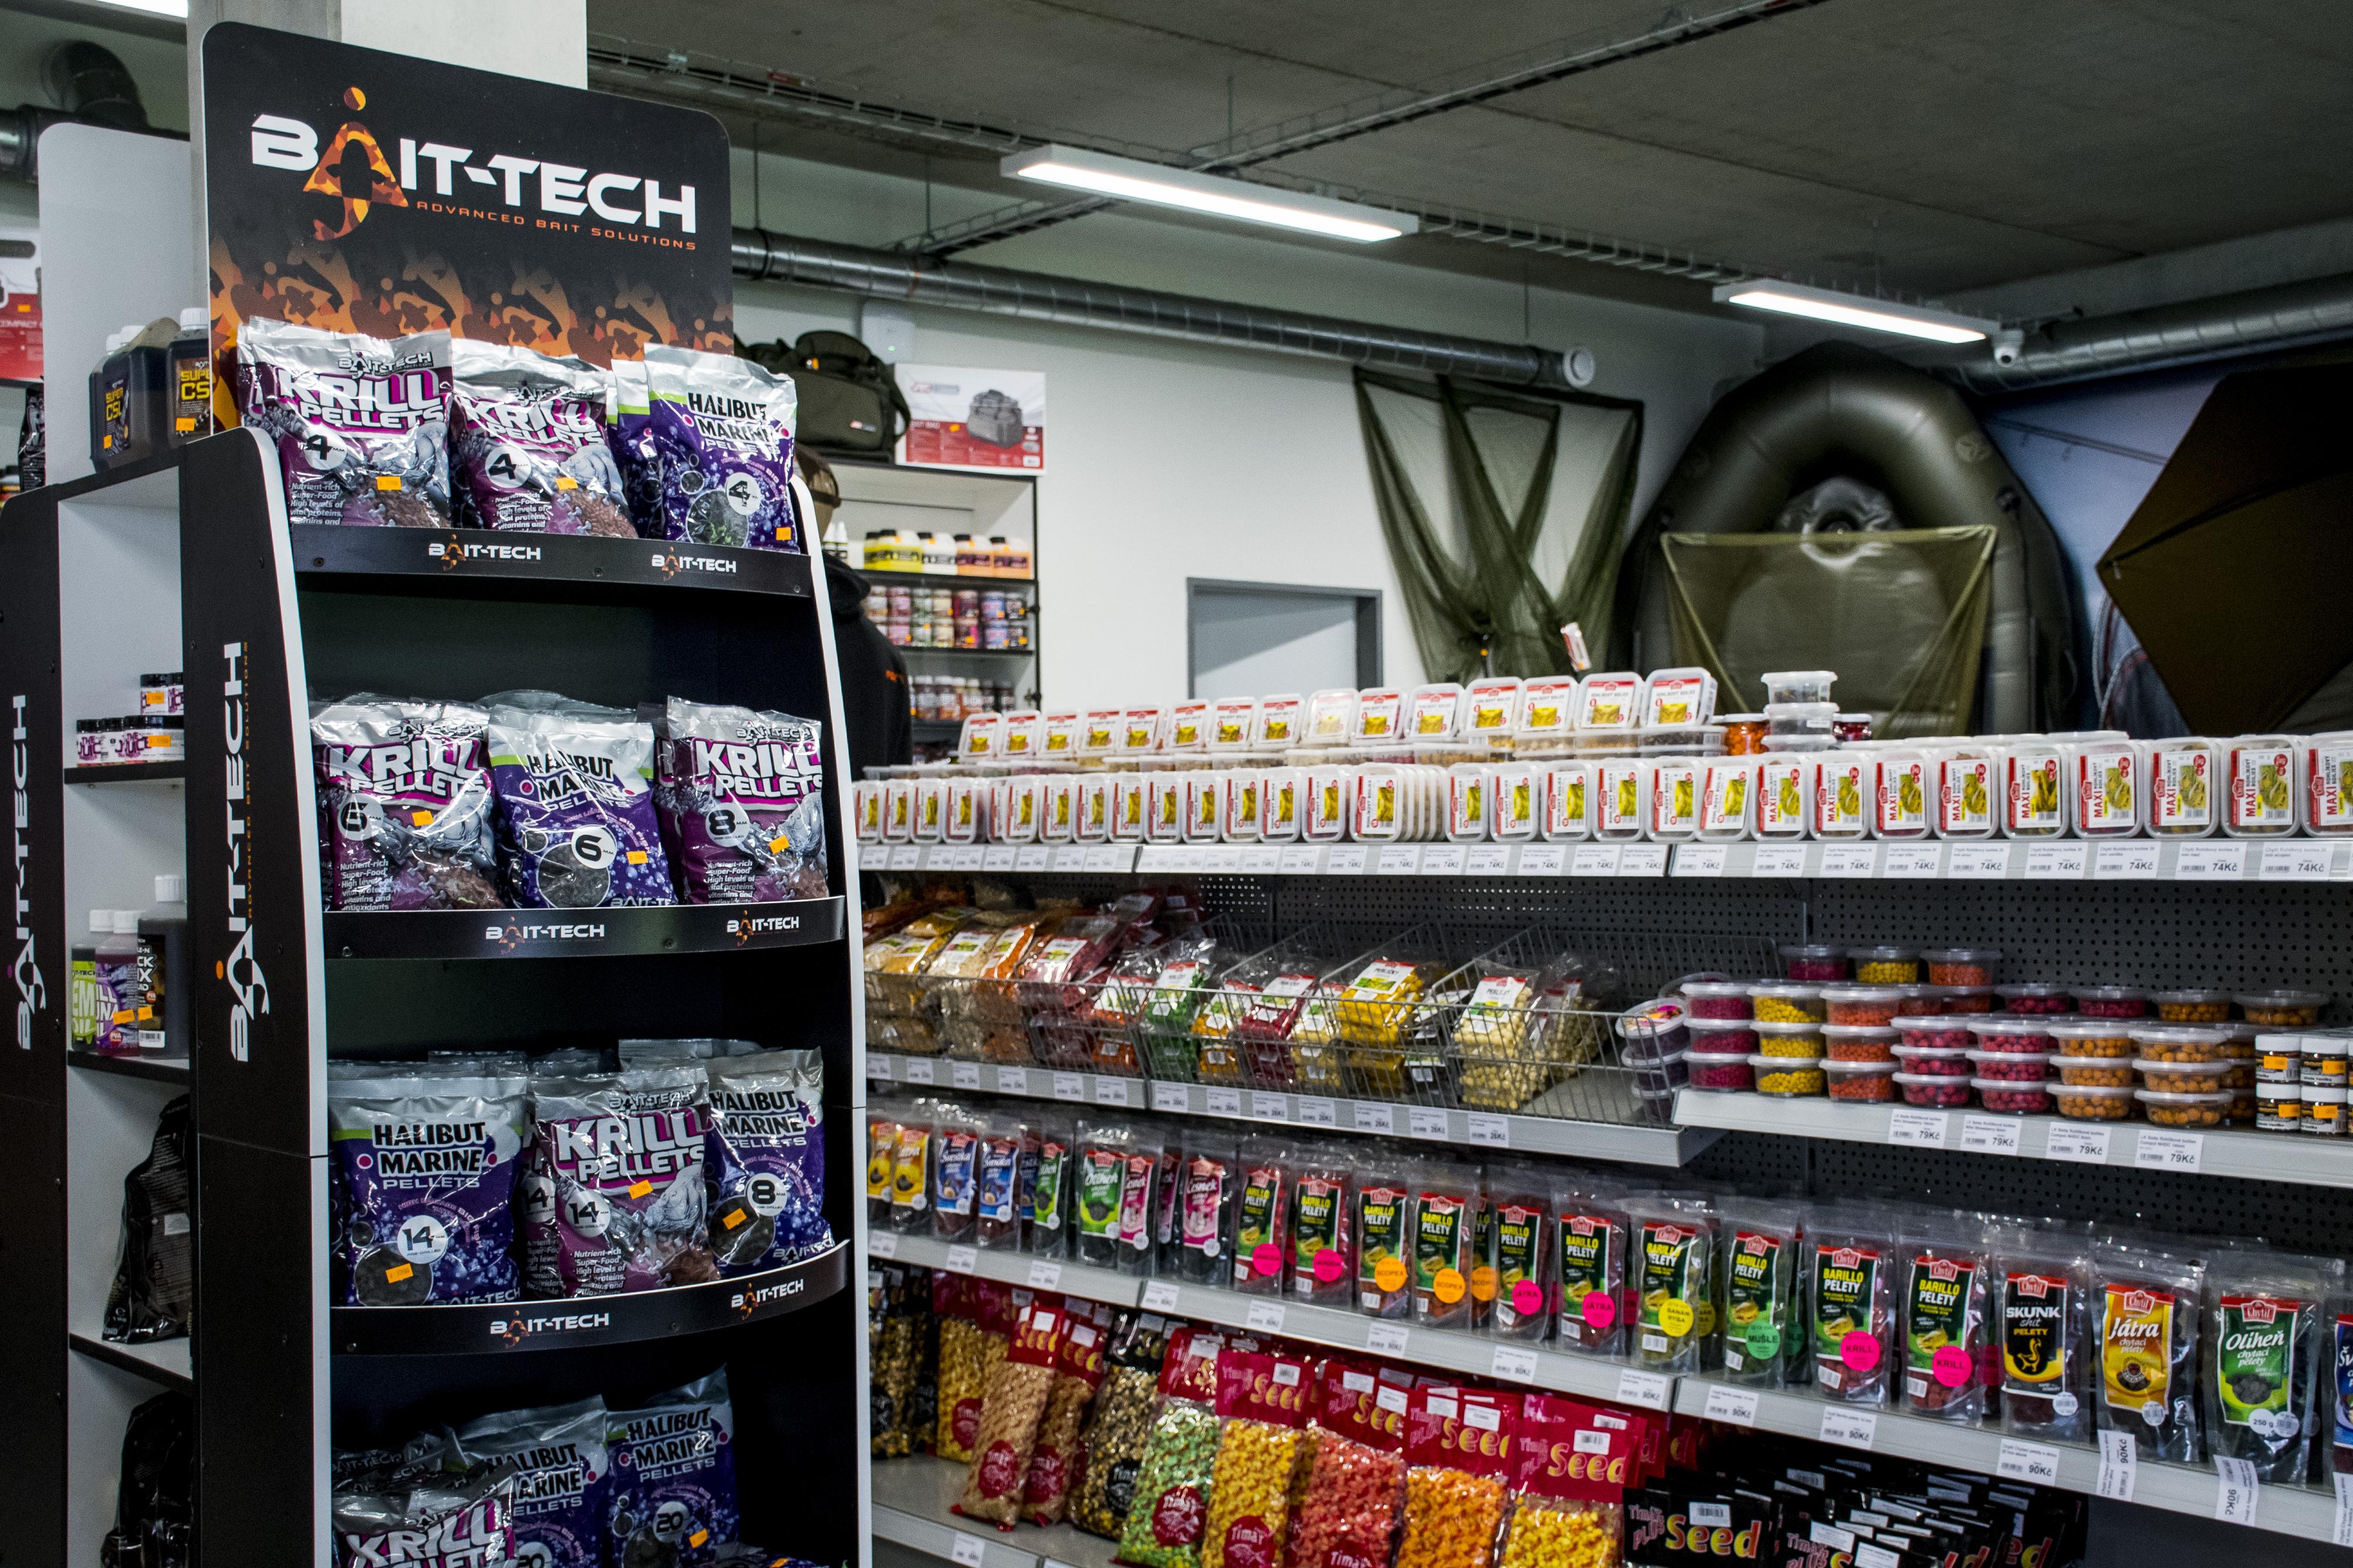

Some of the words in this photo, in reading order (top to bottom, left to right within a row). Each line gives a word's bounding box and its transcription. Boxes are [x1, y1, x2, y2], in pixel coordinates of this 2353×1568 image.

[252, 96, 696, 238] BAIT-TECH
[416, 201, 525, 225] ADVANCED
[536, 219, 580, 233] BAIT
[591, 228, 696, 251] SOLUTIONS
[277, 369, 442, 413] KRILL
[301, 401, 446, 429] PELLETS
[461, 395, 598, 433] KRILL
[688, 392, 766, 421] HALIBUT
[488, 422, 605, 449] PELLETS
[489, 453, 518, 480] 4
[429, 541, 541, 566] BAIT-TECH
[652, 552, 736, 576] BAIT-TECH
[328, 738, 485, 781] KRILL
[695, 740, 822, 778] KRILL
[351, 772, 488, 796] PELLETS
[1952, 795, 1961, 820] MAXI
[2094, 790, 2102, 818] MAXI
[2167, 789, 2175, 816] MAXI
[2246, 789, 2255, 816] MAXI
[2327, 786, 2337, 815] MAXI
[708, 810, 736, 836] 8
[224, 642, 265, 1062] BAIT-TECH
[576, 835, 602, 862] 6
[12, 695, 41, 1050] BAIT-TECH
[341, 859, 388, 870] Nutrient-rich
[1781, 862, 1800, 870] 74Kč
[1850, 862, 1869, 870] 74Kč
[1914, 862, 1934, 870] 74Kč
[2058, 862, 2081, 870] 74Kč
[2212, 863, 2237, 871] 74Kč
[2298, 863, 2324, 872] 74Kč
[342, 880, 357, 889] High
[708, 876, 723, 885] High
[486, 921, 605, 949] BAIT-TECH
[727, 915, 799, 941] BAIT-TECH
[610, 1091, 694, 1115] BAIT-TECH
[374, 1122, 486, 1146] HALIBUT
[556, 1110, 705, 1163] KRILL
[722, 1116, 804, 1136] MARINE
[1992, 1136, 2015, 1147] 79Kč
[2079, 1145, 2103, 1155] 79Kč
[381, 1149, 482, 1175] MARINE
[578, 1145, 705, 1182] PELLETS
[2170, 1153, 2195, 1164] 79Kč
[384, 1177, 479, 1190] PELLETS
[752, 1180, 776, 1205] 8
[569, 1201, 599, 1224] 14
[402, 1226, 434, 1251] 14
[576, 1266, 592, 1276] High
[594, 1266, 616, 1274] levels
[618, 1265, 626, 1273] of
[1735, 1265, 1764, 1279] PELETY
[1737, 1253, 1767, 1270] BARILLO
[1824, 1268, 1864, 1283] BARILLO
[1824, 1280, 1860, 1293] PELETY
[1919, 1280, 1959, 1295] BARILLO
[732, 1280, 804, 1314] BAIT-TECH
[1919, 1292, 1956, 1306] PELETY
[2006, 1307, 2061, 1317] SKUNK
[2019, 1318, 2040, 1327] shit
[491, 1312, 609, 1343] BAIT-TECH
[2108, 1317, 2159, 1339] Játra
[2226, 1331, 2284, 1350] Oliheň
[1937, 1360, 1964, 1369] KRILL
[2238, 1357, 2265, 1367] pelety
[627, 1407, 712, 1443] HALIBUT
[640, 1456, 715, 1482] PELLETS
[2028, 1464, 2052, 1477] 90Kč
[2224, 1489, 2237, 1516] 90Kč
[657, 1509, 684, 1531] 20
[346, 1499, 506, 1568] KRILL
[1665, 1514, 1762, 1559] Seed
